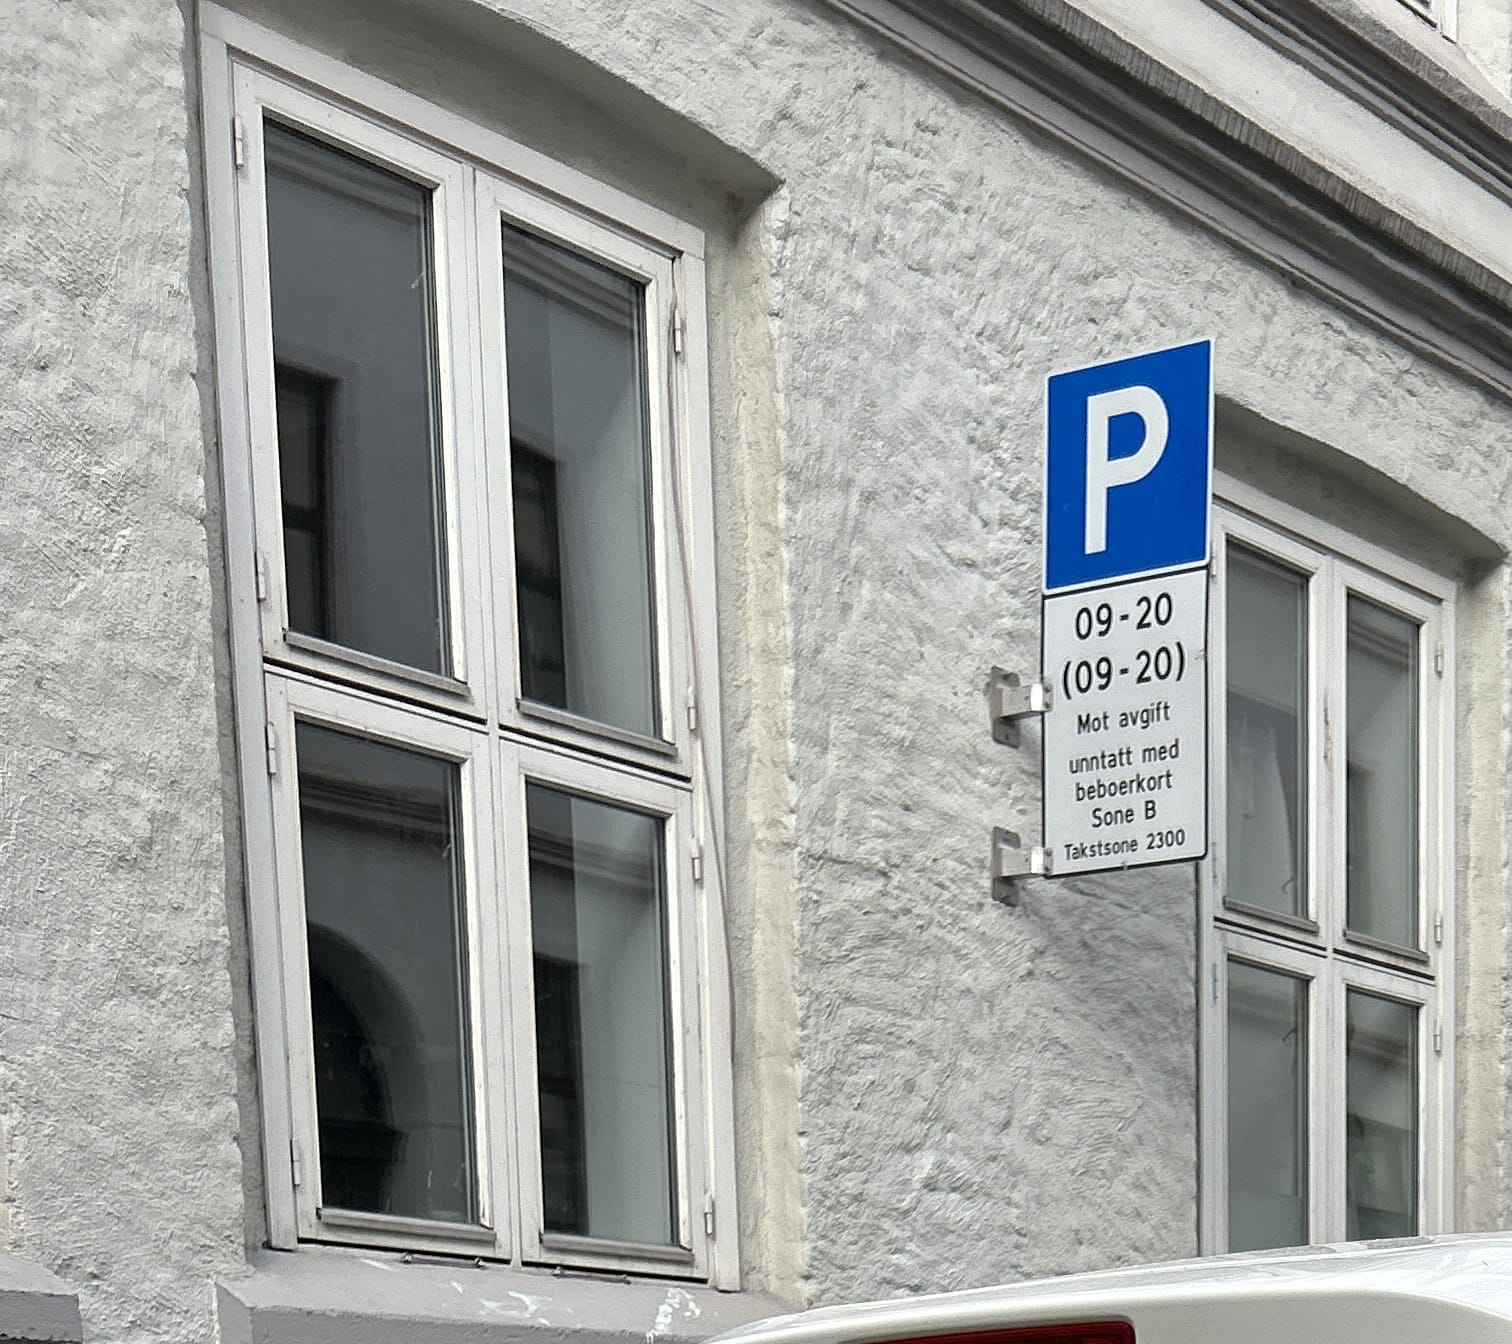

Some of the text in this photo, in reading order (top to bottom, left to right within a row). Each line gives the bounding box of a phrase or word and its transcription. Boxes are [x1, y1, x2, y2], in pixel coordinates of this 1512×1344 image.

[1084, 385, 1169, 555] P
[1077, 701, 1170, 735] Mot avgift
[1069, 738, 1179, 774] unntatt med
[1075, 769, 1173, 801] beboerkort
[1091, 800, 1157, 828] Sone B
[1064, 828, 1186, 861] Takstsone 2300
